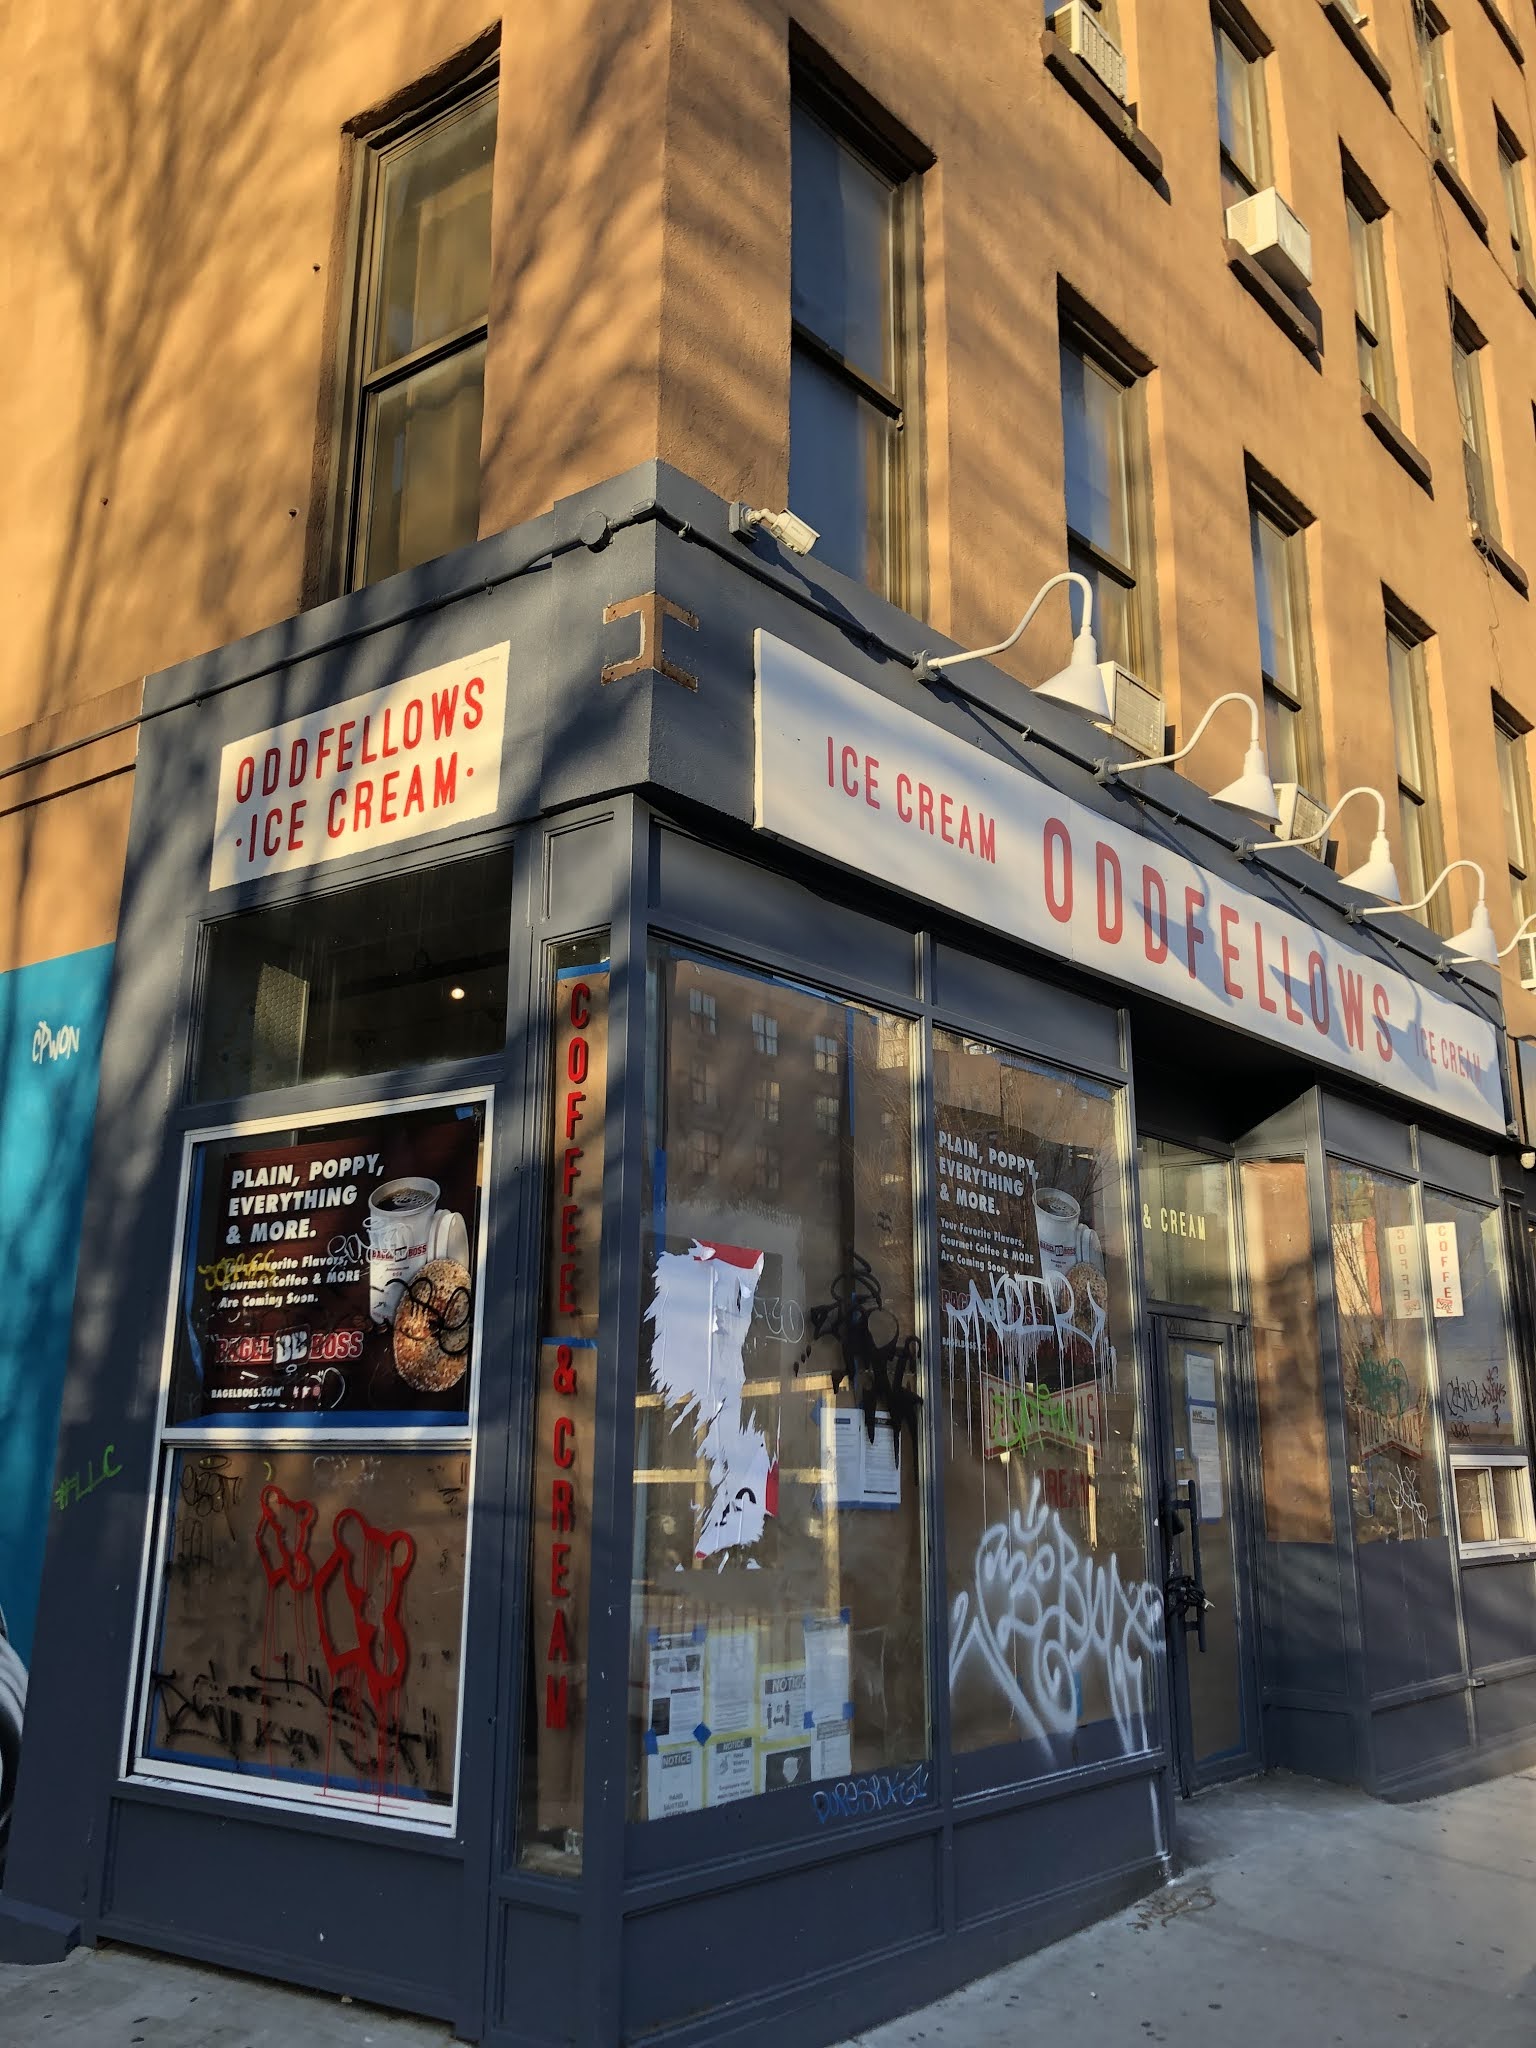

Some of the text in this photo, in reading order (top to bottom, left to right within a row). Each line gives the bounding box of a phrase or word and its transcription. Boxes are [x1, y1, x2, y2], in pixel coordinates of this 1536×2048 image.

[236, 677, 485, 804] ODDFELLOWS
[827, 737, 1482, 1082] ICE CREAM ODDFELLOWS ICE CREAM
[231, 1153, 384, 1189] PLAIN, POPPY,
[939, 1130, 1039, 1180] PLAIN, POPPY,
[939, 1156, 1025, 1197] EVERYTHING
[228, 1185, 357, 1217] EVERYTHING
[940, 1183, 1001, 1216] & MORE.
[225, 1225, 241, 1245] &
[250, 1218, 317, 1243] MORE.
[940, 1217, 1025, 1249] Your Favorite Flavors,
[1143, 1203, 1206, 1241] & CREAM
[940, 1233, 973, 1250] Gourmet
[975, 1242, 1001, 1257] Coffee
[1002, 1249, 1009, 1259] &
[1012, 1251, 1034, 1264] MORE
[941, 1250, 1009, 1274] Are Coming Soon.
[222, 1270, 360, 1291] Gourmet Coffee & MORE
[219, 1297, 239, 1309] Are
[243, 1292, 282, 1308] Coming
[309, 1330, 364, 1360] BOSS
[545, 982, 591, 1730] COFFEE & CREAM
[662, 1752, 692, 1768] NOTICE
